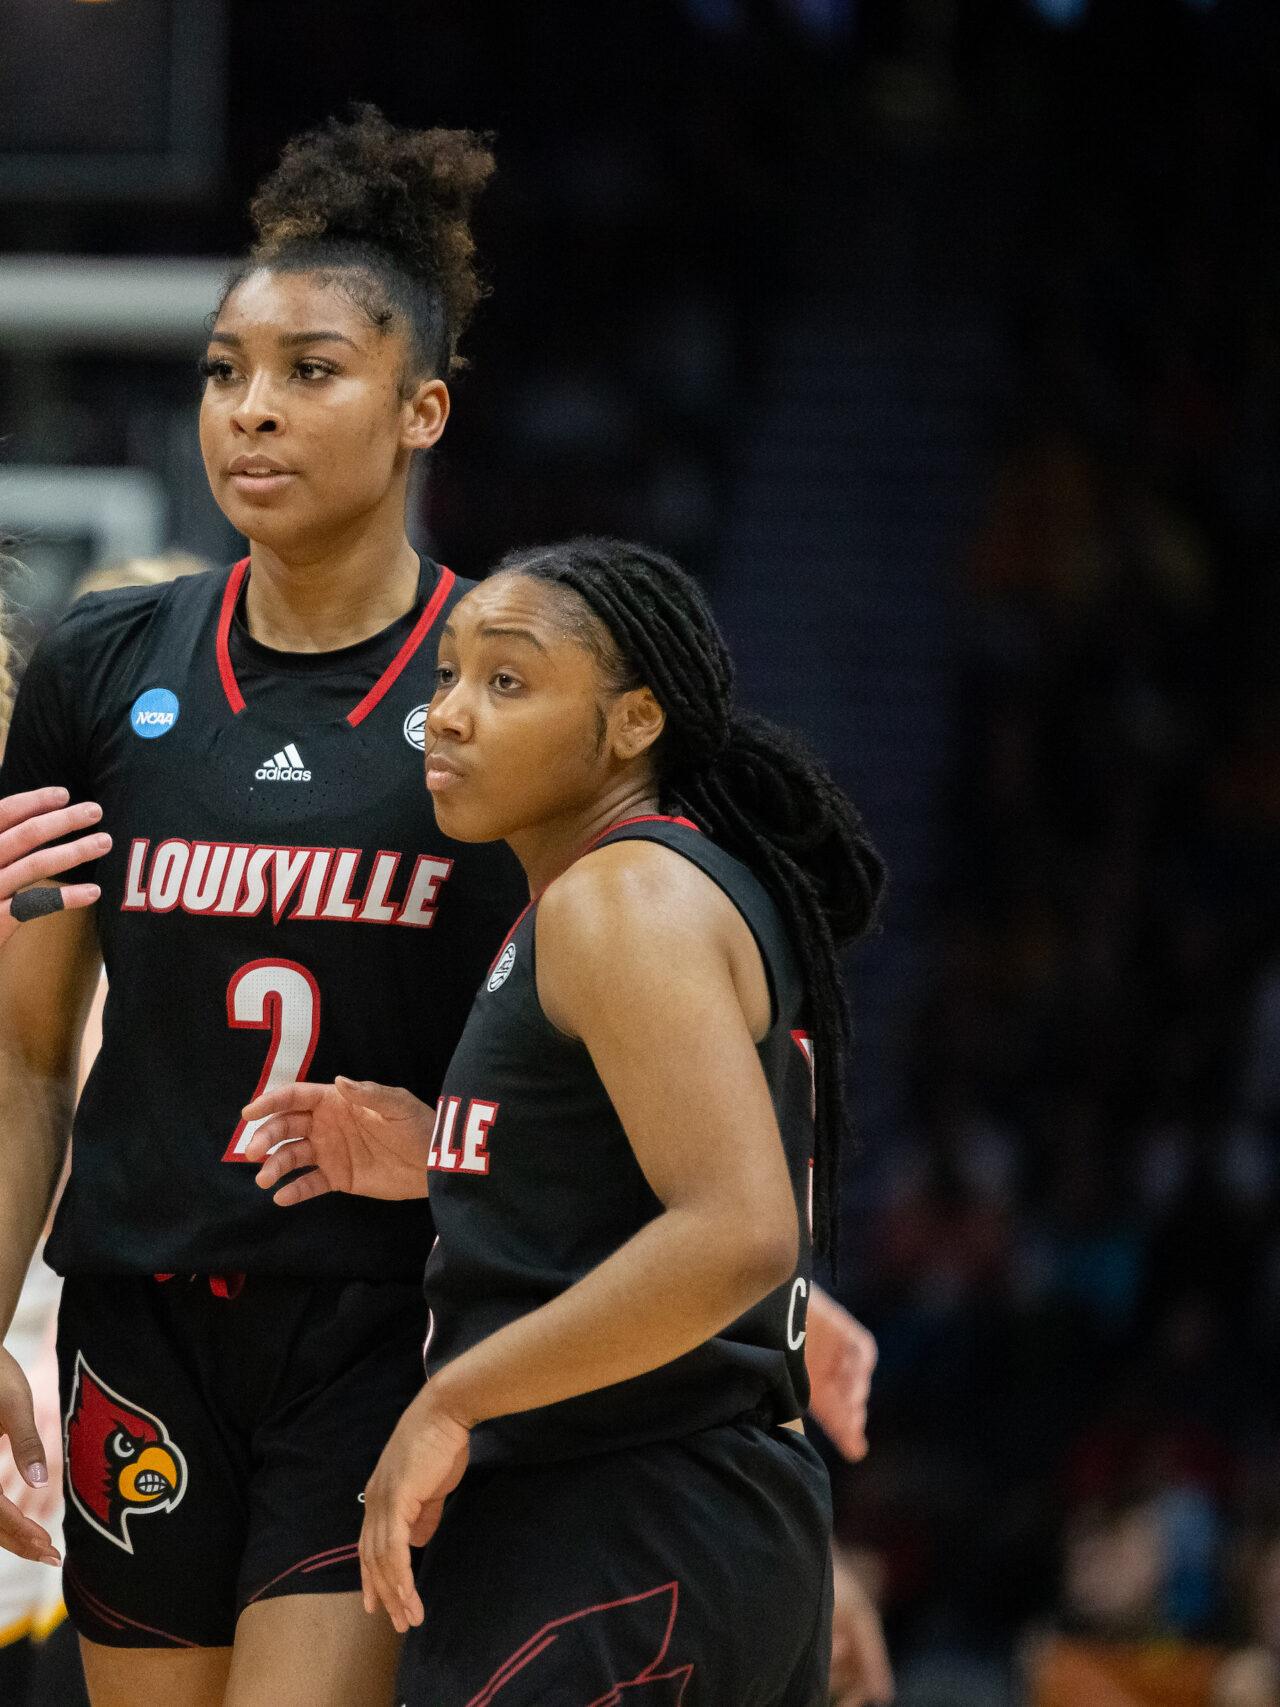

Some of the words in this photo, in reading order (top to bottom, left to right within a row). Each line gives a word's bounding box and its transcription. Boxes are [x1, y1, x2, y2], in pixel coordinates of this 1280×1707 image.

[135, 711, 175, 726] NCAA
[254, 766, 312, 782] adidas
[120, 837, 455, 929] LOUISVILLE
[221, 957, 321, 1164] 2
